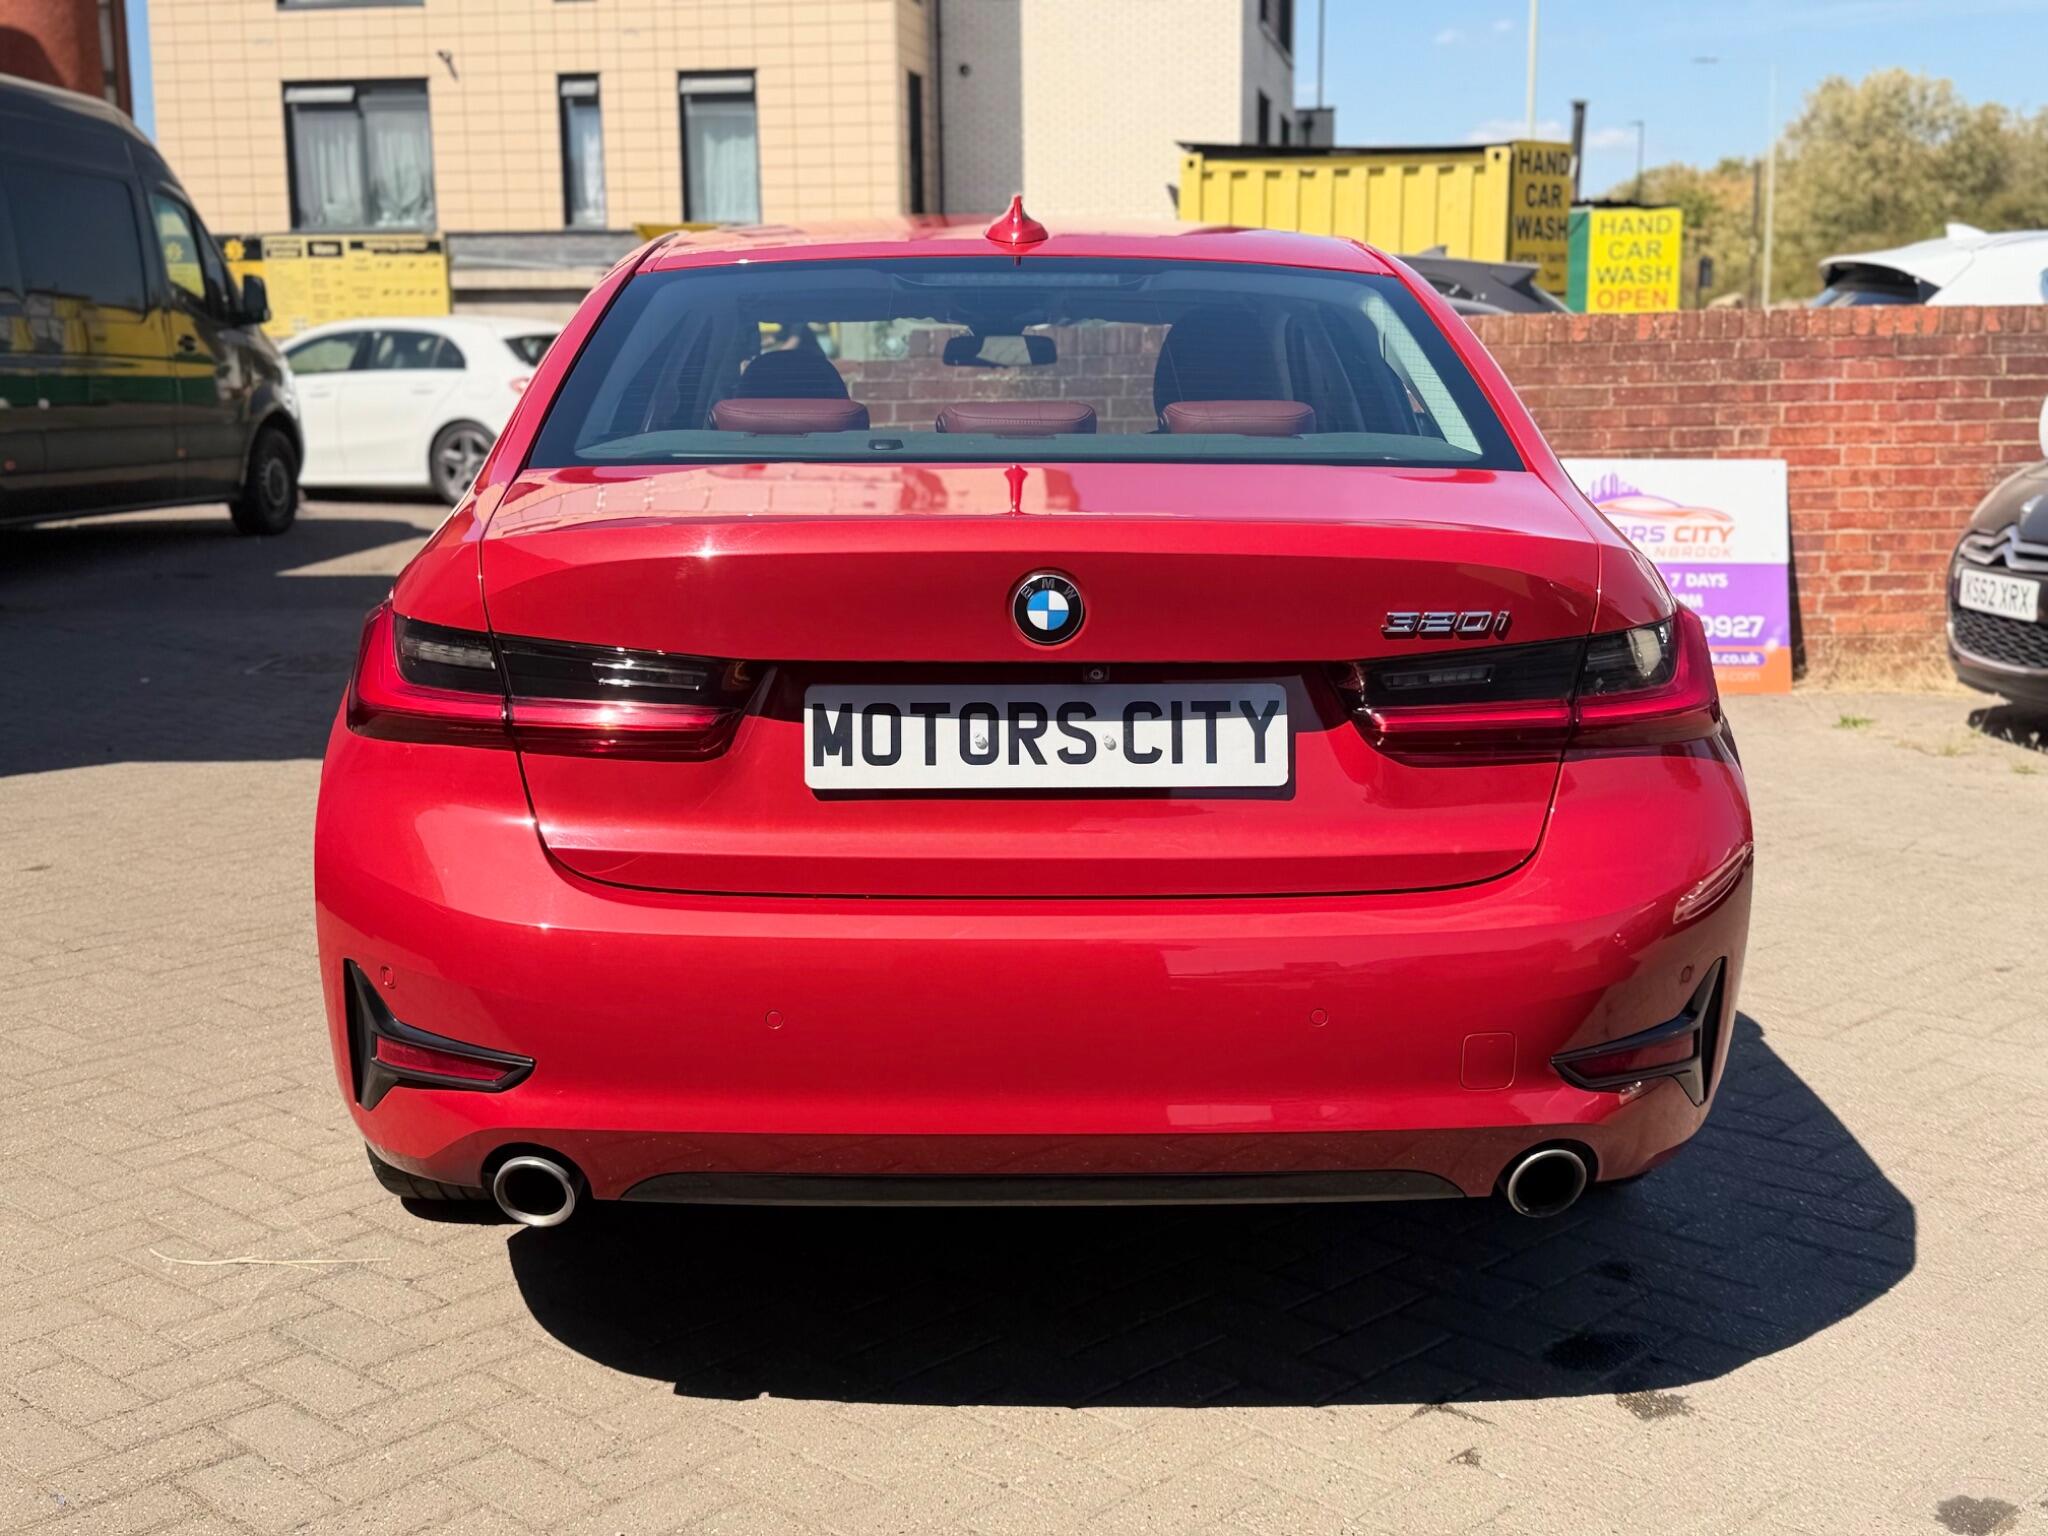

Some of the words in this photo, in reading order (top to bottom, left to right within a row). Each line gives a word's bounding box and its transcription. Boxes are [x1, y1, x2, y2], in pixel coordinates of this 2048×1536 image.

[1519, 149, 1569, 176] HAND
[1525, 183, 1562, 208] CAR
[1516, 215, 1568, 240] WASH
[1599, 214, 1672, 236] HAND
[1607, 239, 1662, 261] CAR
[1596, 264, 1672, 285] WASH
[1596, 288, 1668, 310] OPEN
[1673, 525, 1735, 543] CITY
[1020, 578, 1077, 600] BMW
[1670, 572, 1682, 588] 7
[1685, 572, 1728, 588] DAYS
[1381, 610, 1511, 636] 320i
[811, 700, 1097, 767] MOTORS
[1122, 700, 1281, 765] CITY
